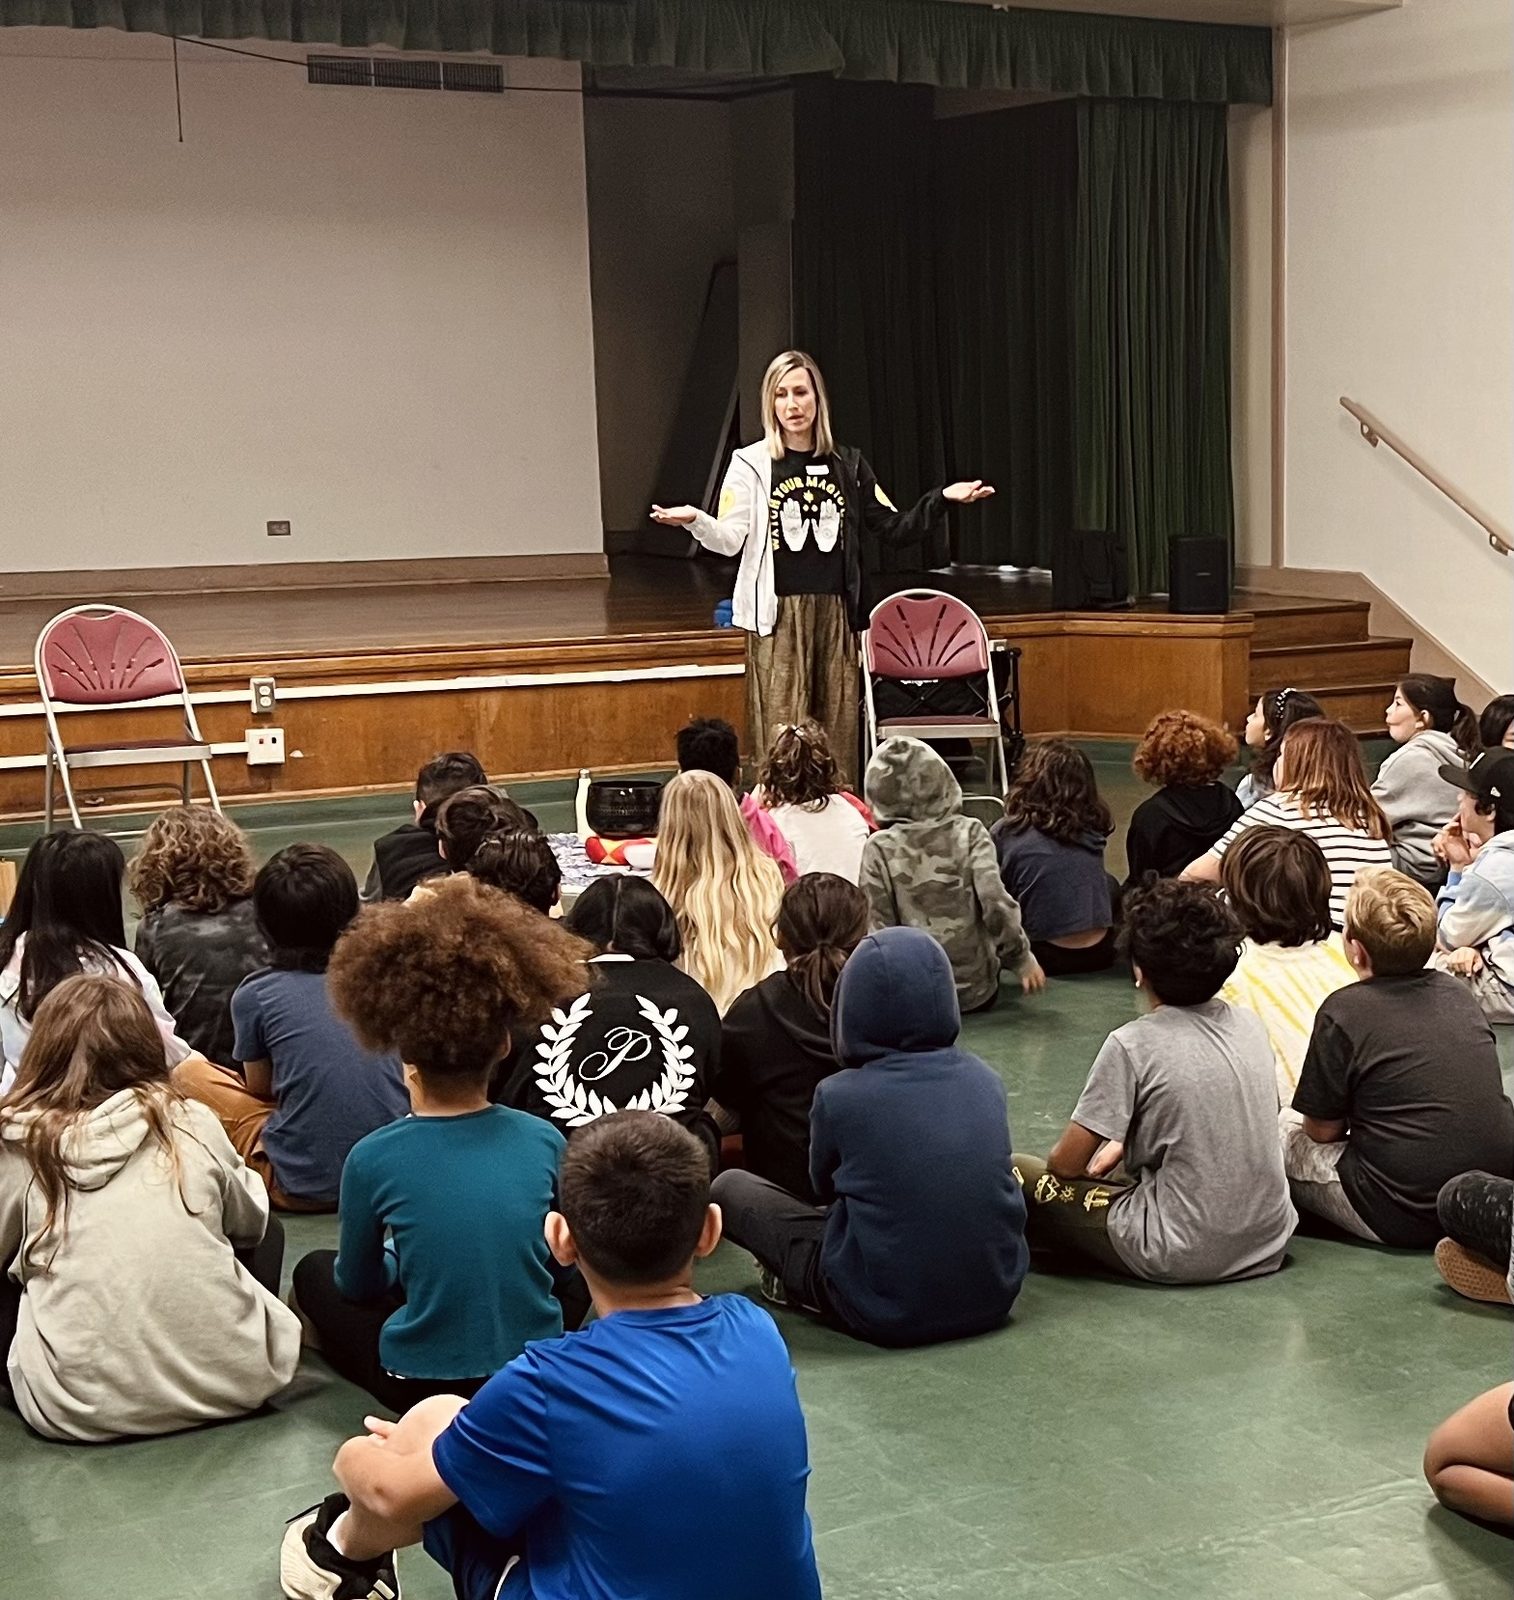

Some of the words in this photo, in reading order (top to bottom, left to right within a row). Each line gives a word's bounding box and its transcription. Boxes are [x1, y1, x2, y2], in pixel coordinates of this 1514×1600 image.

[772, 476, 804, 499] YOUR
[806, 475, 845, 506] MAGIC
[578, 1026, 652, 1081] P
